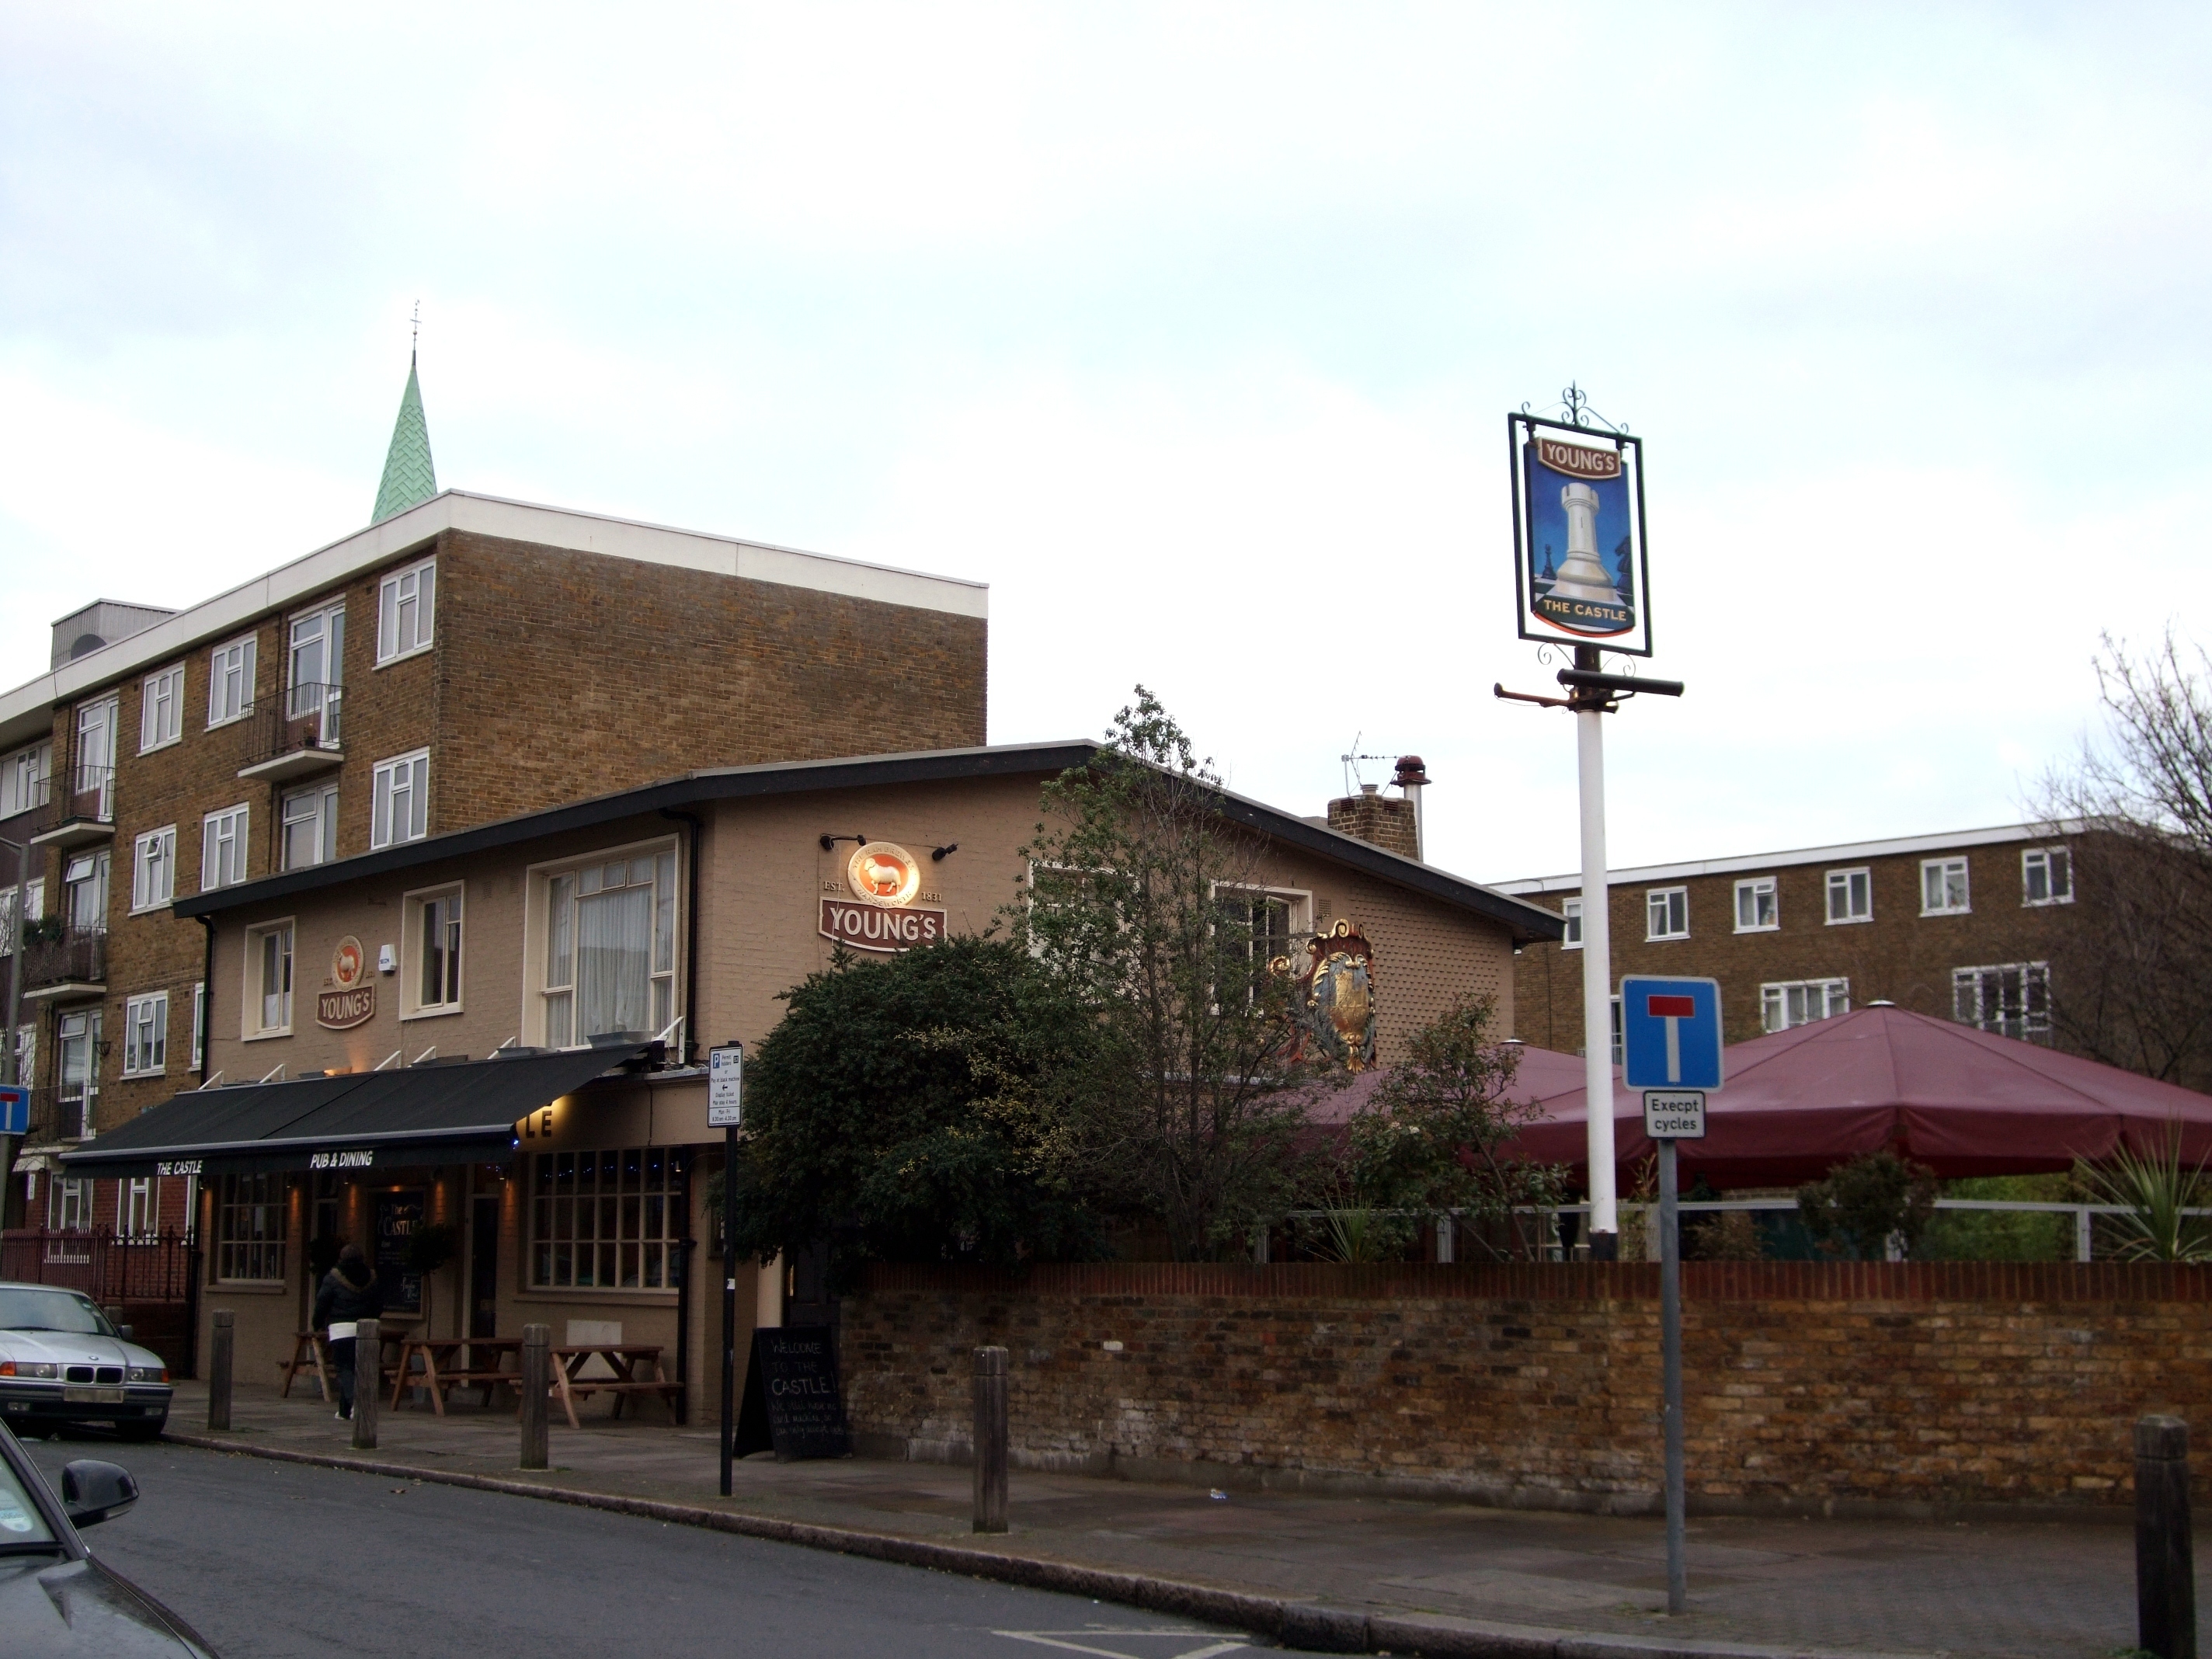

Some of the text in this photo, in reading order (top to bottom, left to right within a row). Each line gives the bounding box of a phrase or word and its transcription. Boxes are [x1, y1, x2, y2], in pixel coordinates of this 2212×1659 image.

[1546, 442, 1616, 471] YOUNG'S
[1543, 599, 1627, 621] THE CASTLE
[823, 881, 942, 902] EST. 1831
[830, 907, 937, 941] YOUNG'S
[322, 991, 370, 1020] YOUNG'S
[1652, 1098, 1699, 1114] Execpt
[1655, 1117, 1696, 1132] cycles
[157, 1160, 203, 1175] THE CASTLE
[310, 1150, 373, 1169] PUB & DINING
[770, 1337, 823, 1355] WELCOME
[771, 1361, 818, 1373] TO THE
[771, 1371, 836, 1396] CASTLE!
